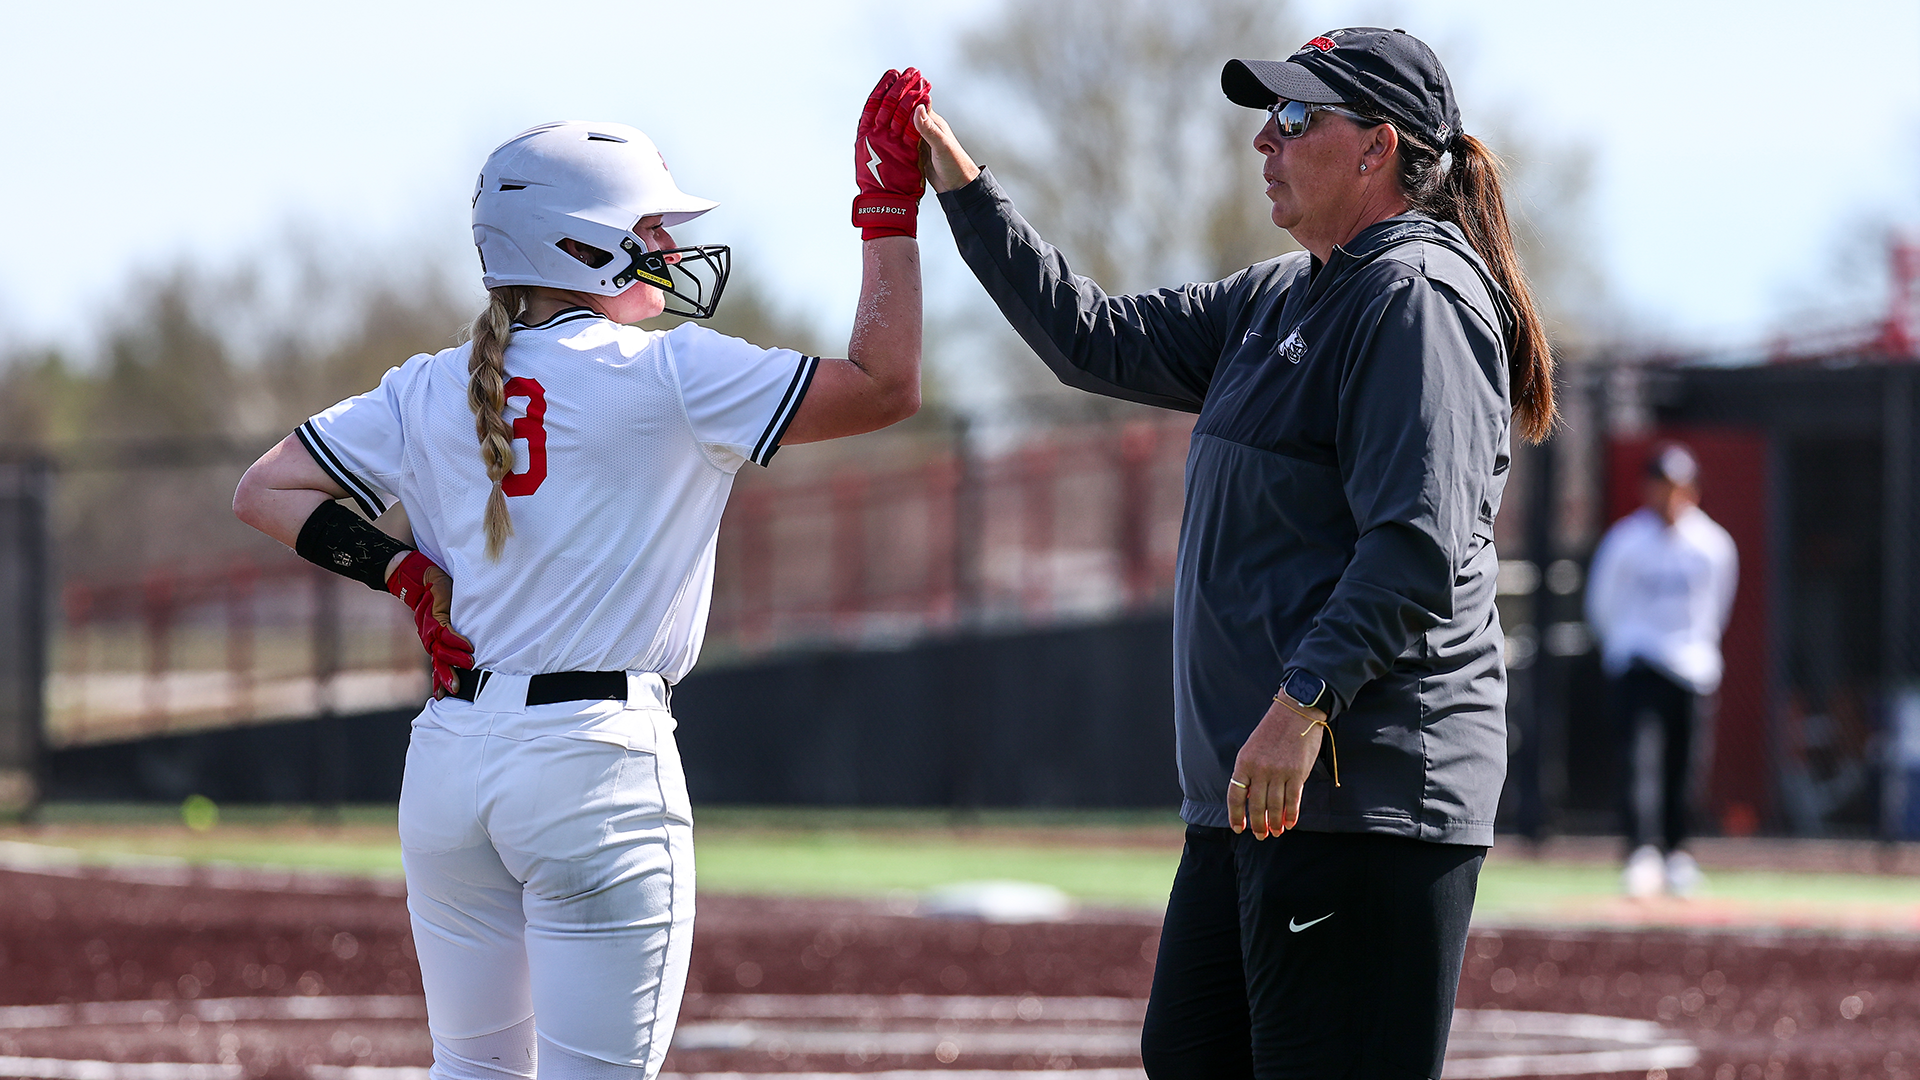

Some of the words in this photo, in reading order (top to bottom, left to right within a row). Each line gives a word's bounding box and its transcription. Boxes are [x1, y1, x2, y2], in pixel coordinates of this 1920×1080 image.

[858, 206, 880, 214] BRUCE
[886, 206, 907, 215] BOLT
[500, 376, 547, 497] 3
